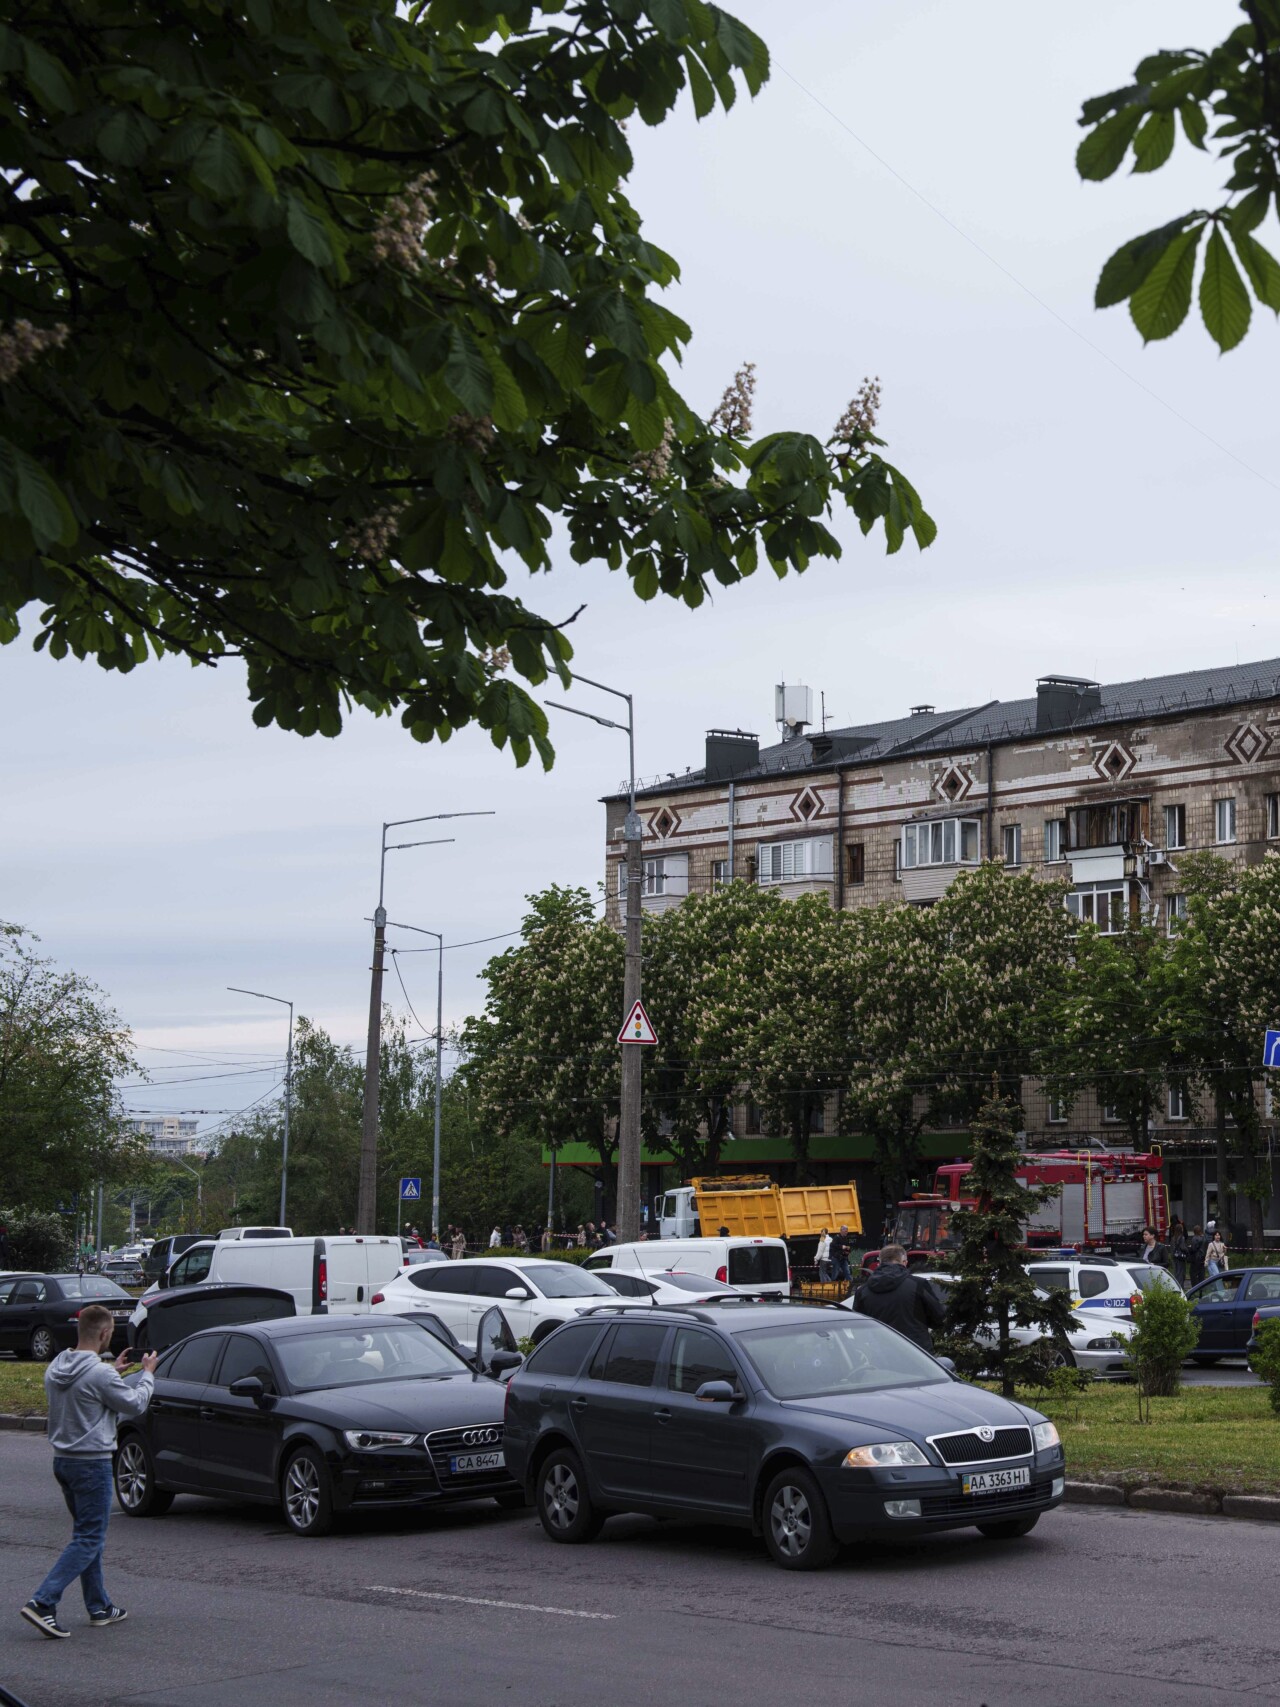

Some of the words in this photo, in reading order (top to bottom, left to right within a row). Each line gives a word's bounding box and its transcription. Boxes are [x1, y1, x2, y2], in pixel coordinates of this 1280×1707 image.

[1113, 1299, 1126, 1307] 102
[458, 1457, 473, 1469] CA
[476, 1454, 500, 1467] 8447
[971, 1475, 986, 1489] AA
[989, 1472, 1011, 1487] 3363
[1014, 1470, 1026, 1483] HI
